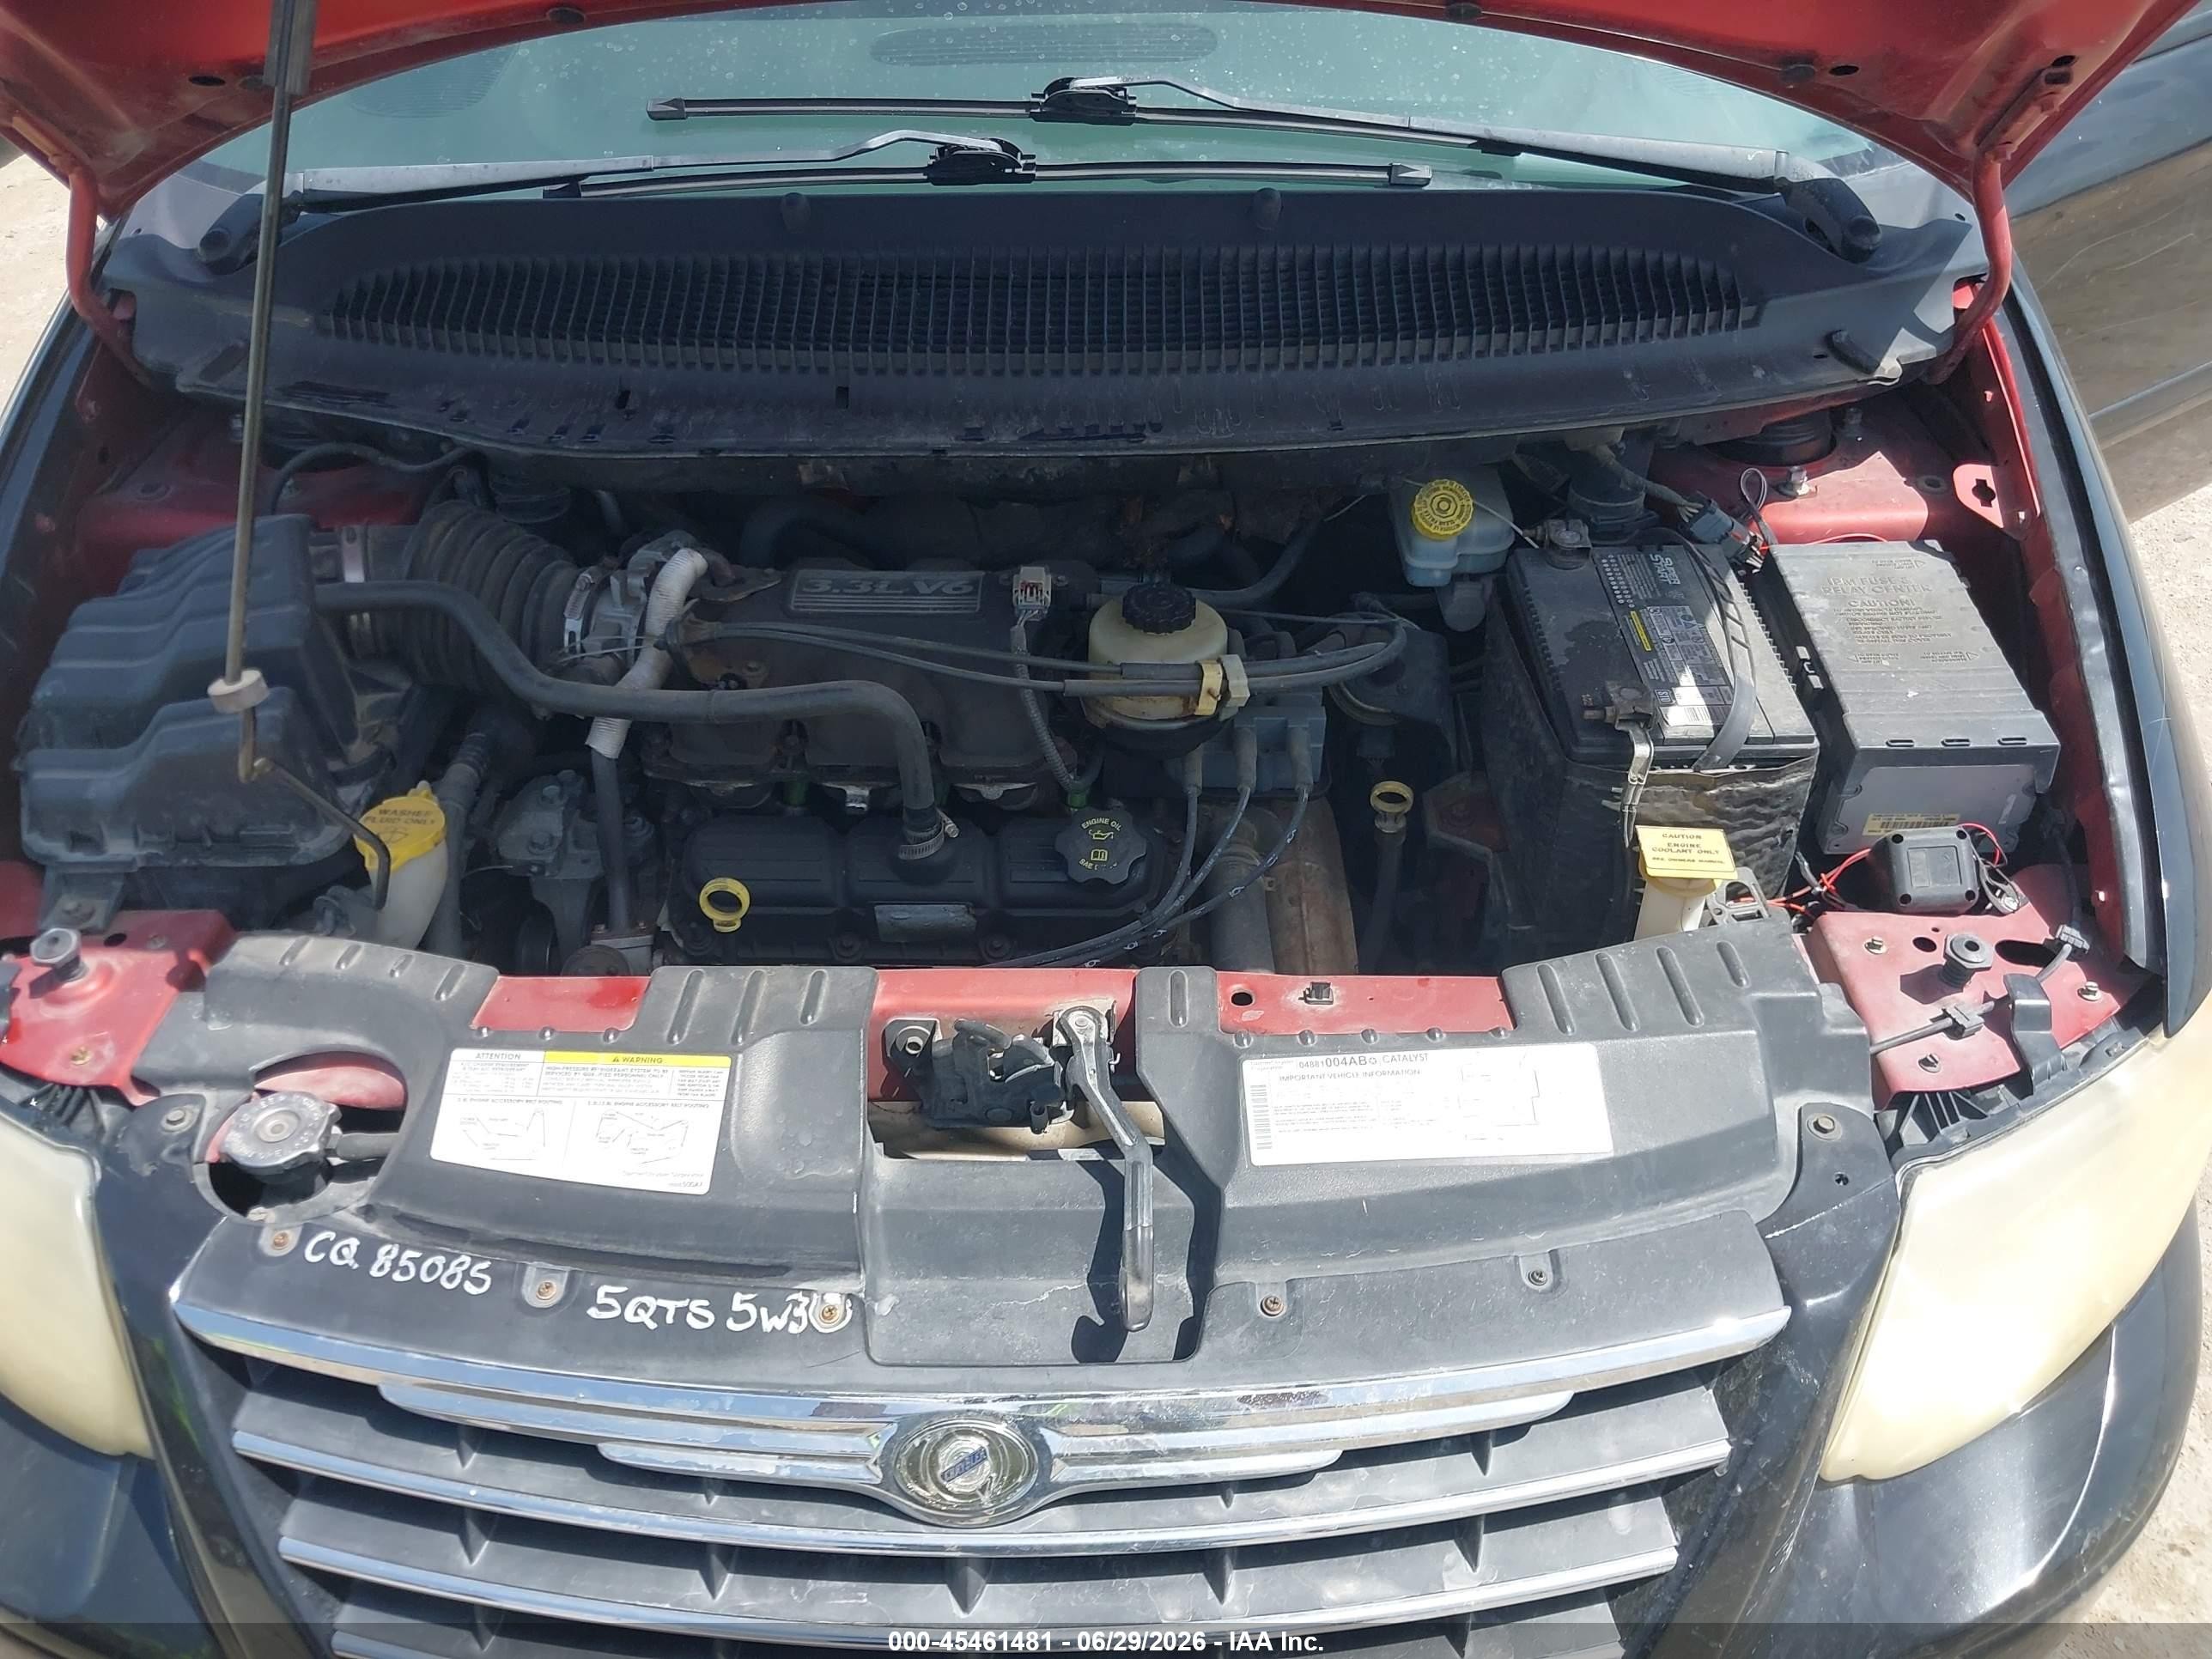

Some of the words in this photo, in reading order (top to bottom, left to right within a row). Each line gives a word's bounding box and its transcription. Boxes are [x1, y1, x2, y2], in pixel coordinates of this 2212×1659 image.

[1860, 576, 1896, 585] FUSE
[803, 580, 909, 593] 3.3L
[914, 580, 974, 594] V6
[1821, 586, 1866, 595] RELAY
[1871, 584, 1932, 594] CENTER
[1848, 599, 1915, 607] CAUTION!
[1081, 817, 1109, 830] ENGINE
[1110, 820, 1121, 831] OIL
[1382, 1053, 1429, 1064] CATALYST
[304, 1231, 360, 1269] CQ
[586, 1285, 715, 1330] 5QTS
